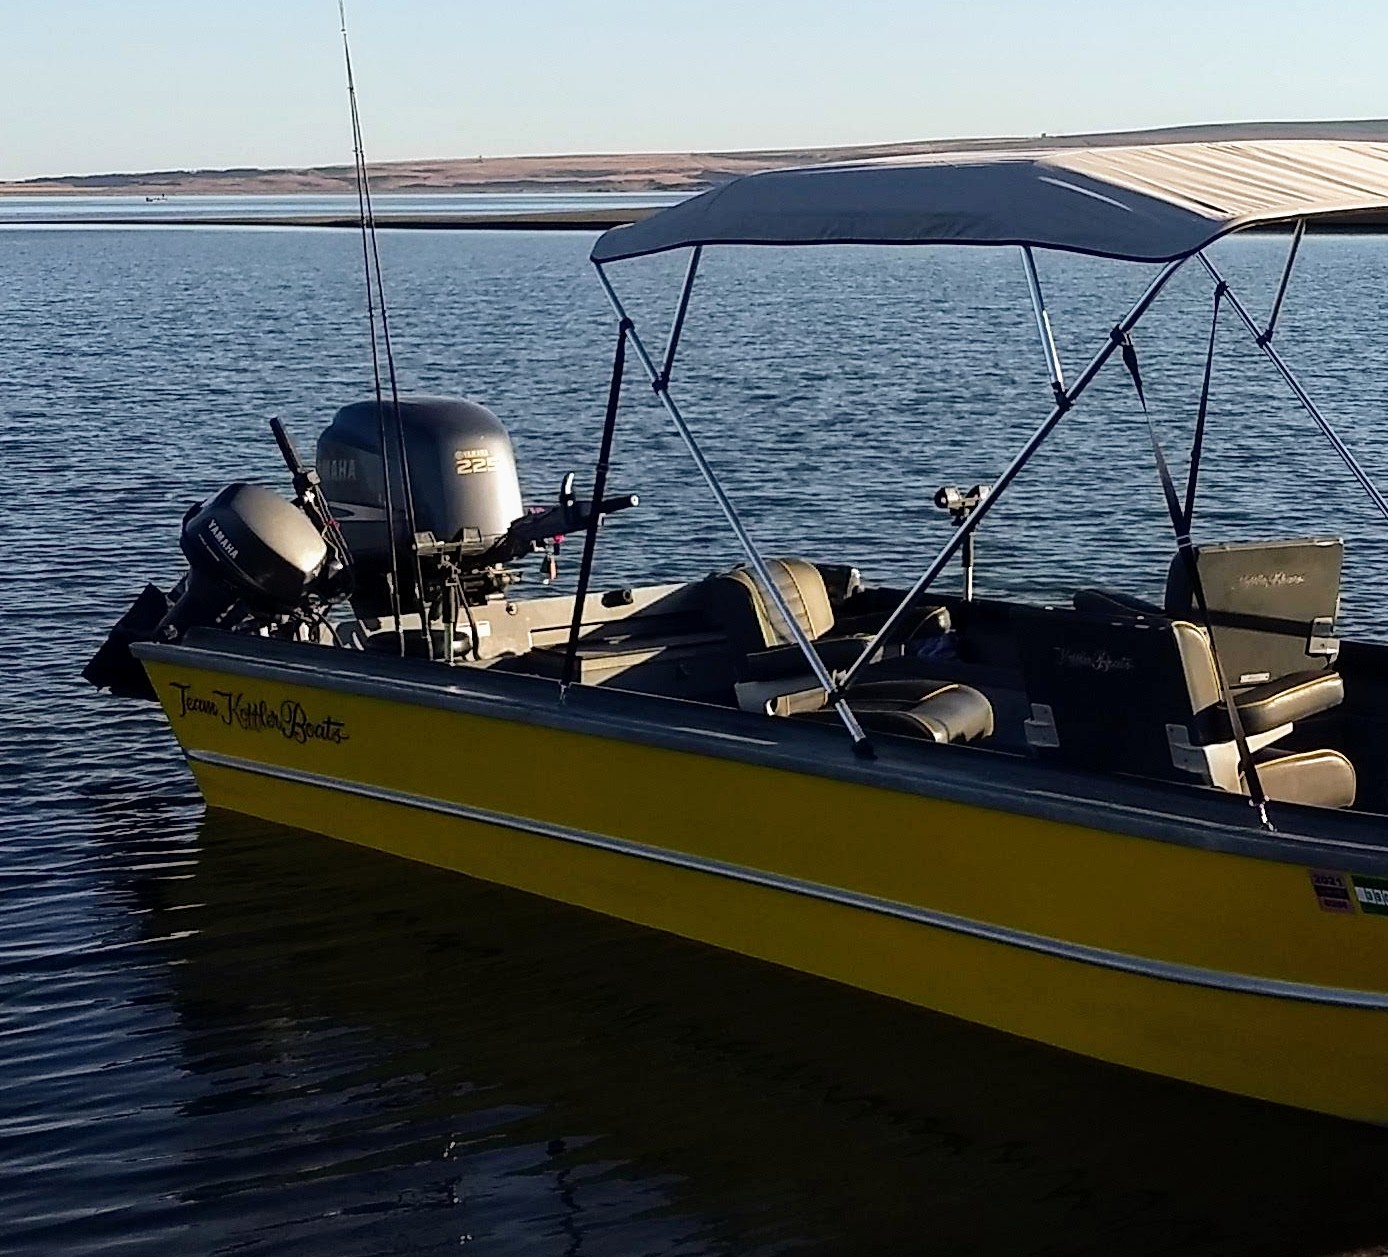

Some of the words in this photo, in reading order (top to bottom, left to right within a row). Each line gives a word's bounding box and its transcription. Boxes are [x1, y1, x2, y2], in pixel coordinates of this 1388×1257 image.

[456, 457, 498, 475] 225
[208, 519, 239, 559] YAMAHA
[169, 682, 219, 718] Team
[280, 700, 350, 744] Boats
